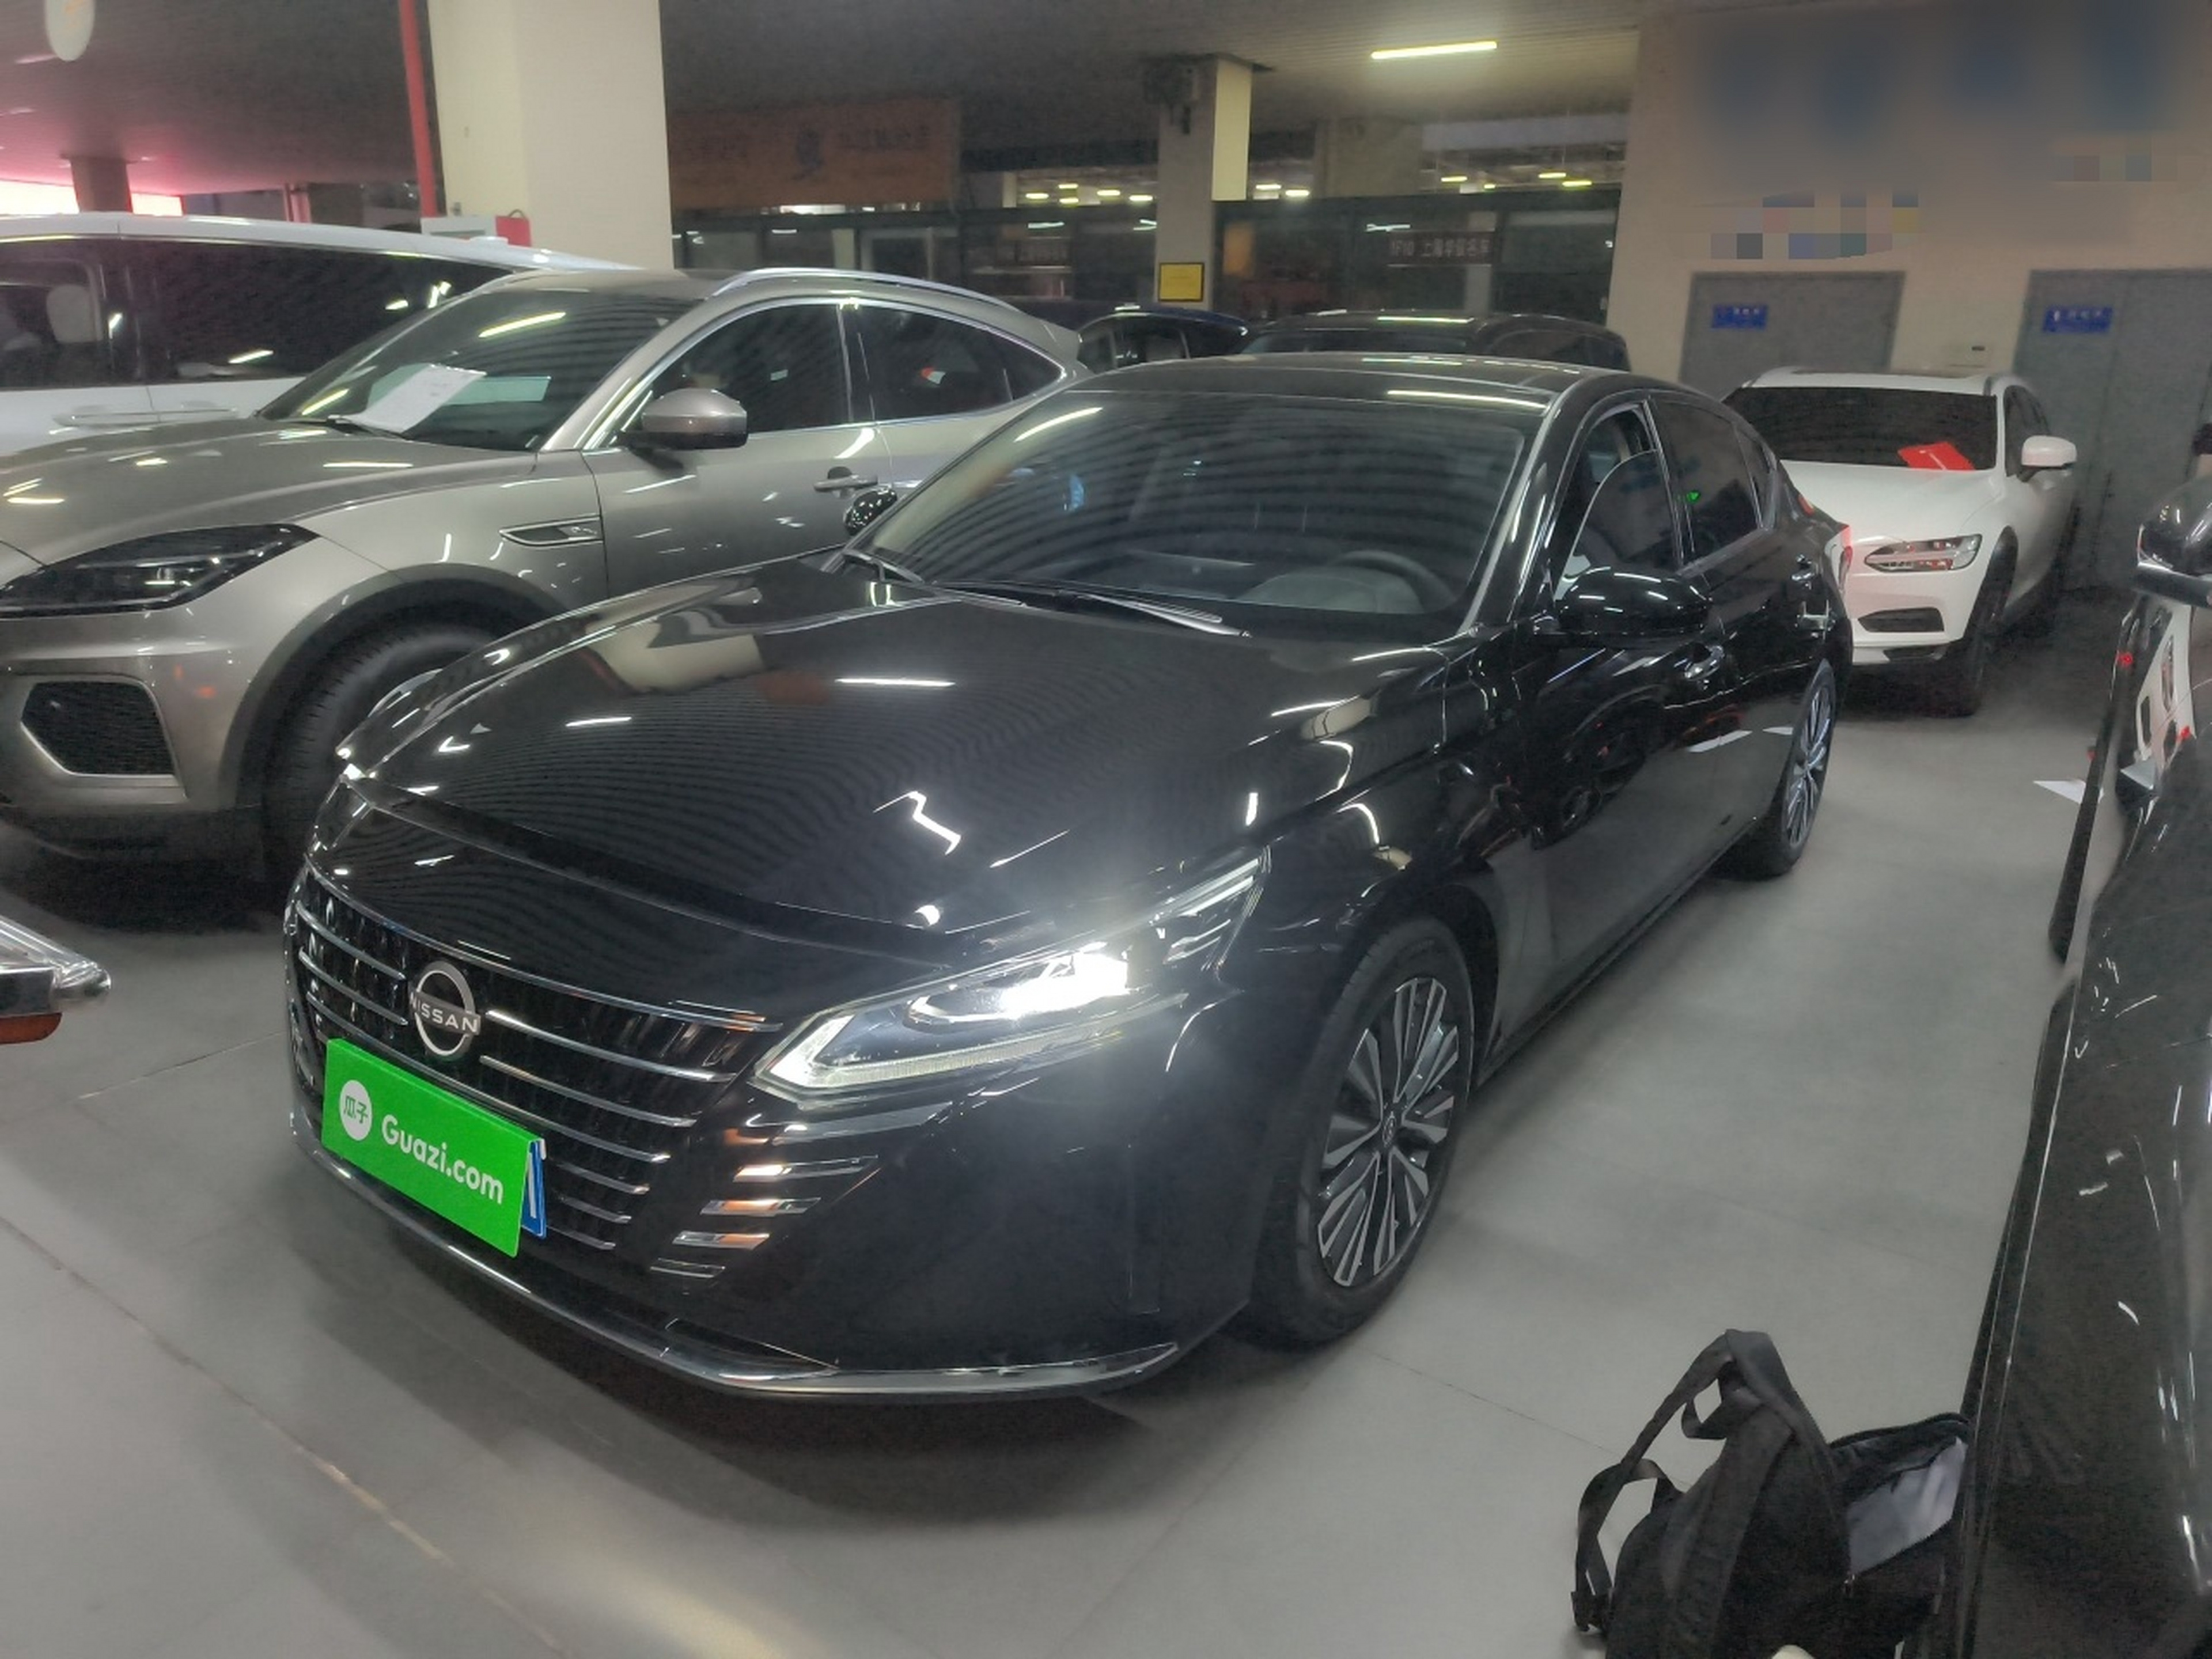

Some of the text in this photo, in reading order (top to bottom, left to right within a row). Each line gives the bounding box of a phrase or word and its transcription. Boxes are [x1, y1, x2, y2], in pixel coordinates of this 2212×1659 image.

[409, 991, 478, 1033] NISSAN
[344, 1094, 369, 1124] 瓜子
[381, 1114, 504, 1205] Guazi.com
